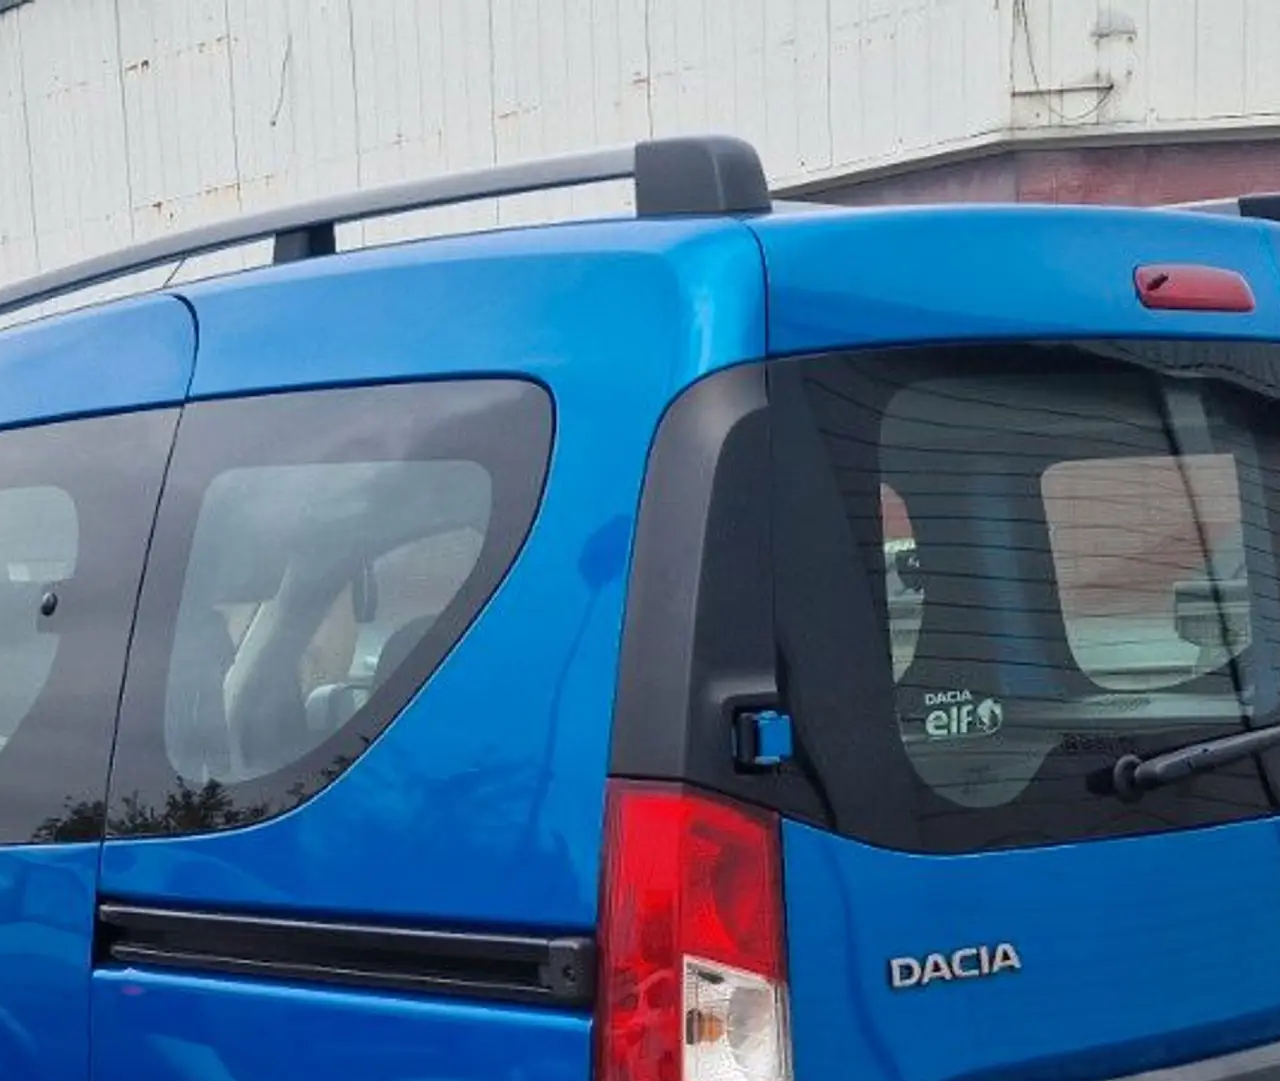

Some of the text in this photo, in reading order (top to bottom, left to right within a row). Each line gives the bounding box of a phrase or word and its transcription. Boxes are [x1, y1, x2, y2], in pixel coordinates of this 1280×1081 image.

[924, 689, 973, 706] DACIA
[925, 704, 975, 737] elf
[889, 942, 1022, 988] DACIA
